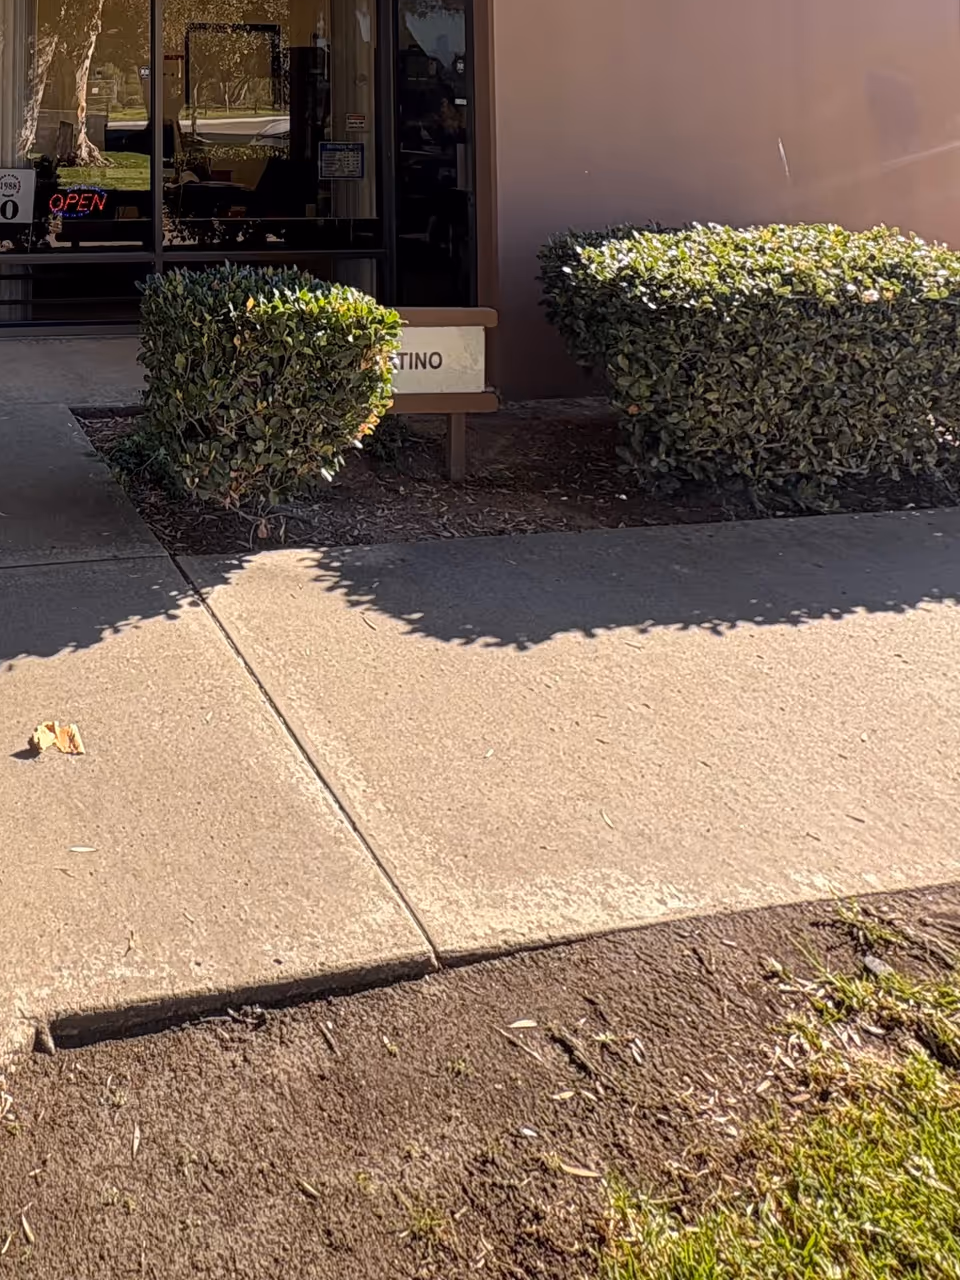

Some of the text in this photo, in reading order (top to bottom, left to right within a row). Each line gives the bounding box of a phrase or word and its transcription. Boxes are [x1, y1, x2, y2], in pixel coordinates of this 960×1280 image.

[0, 181, 18, 191] 1988
[49, 193, 108, 212] OPEN
[391, 350, 444, 370] TINO
